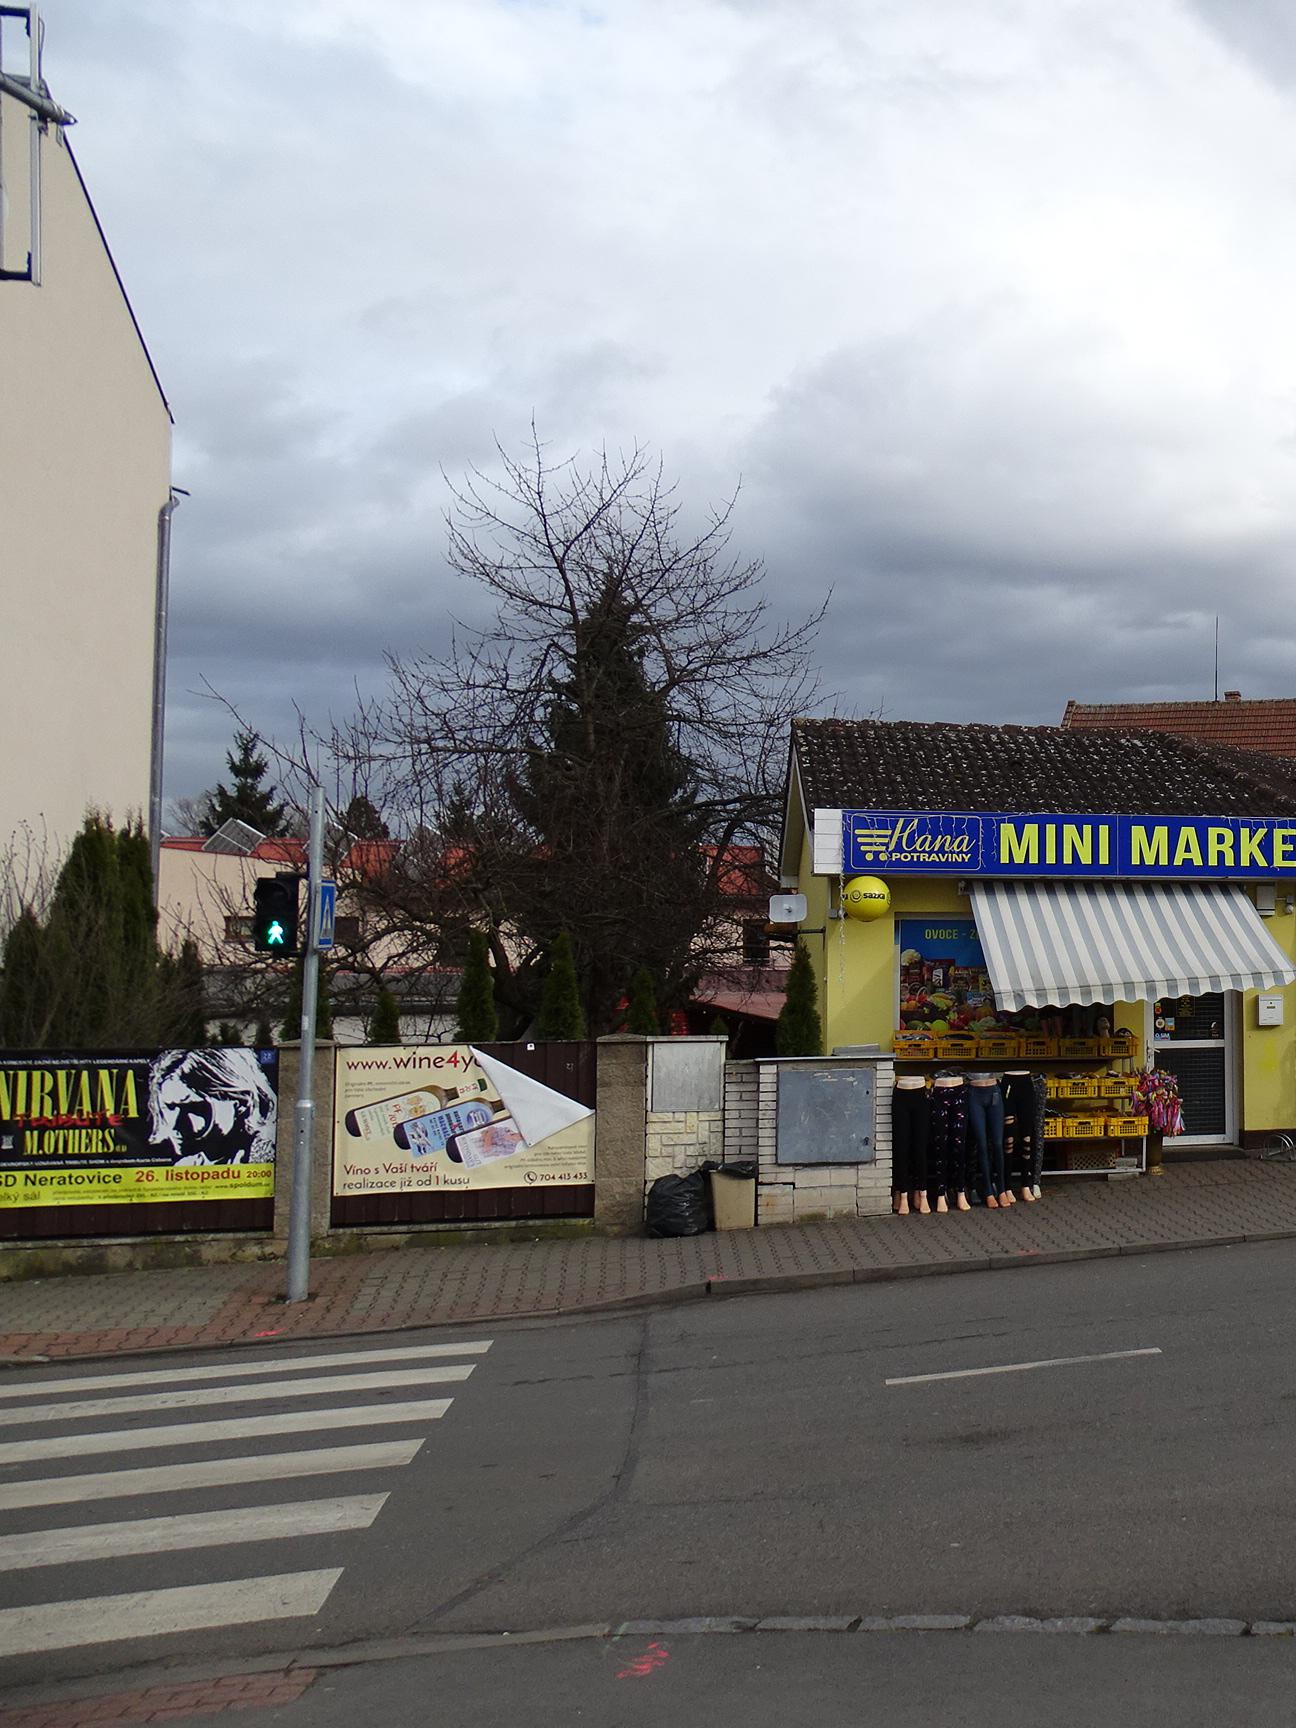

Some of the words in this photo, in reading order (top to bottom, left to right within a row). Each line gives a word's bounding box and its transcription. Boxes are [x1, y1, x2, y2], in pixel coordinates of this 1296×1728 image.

[889, 817, 976, 851] Hana
[999, 823, 1109, 865] MINI
[891, 852, 972, 863] POTRAVINY
[925, 929, 958, 940] OVOCE
[0, 1069, 139, 1120] NIRVANA
[23, 1128, 116, 1155] M.OTHERS
[344, 1164, 371, 1176] Víno
[382, 1162, 408, 1174] Vaší
[410, 1160, 438, 1173] tváří
[24, 1171, 122, 1187] Neratovice
[135, 1170, 159, 1182] 26.
[165, 1168, 241, 1183] listopadu
[246, 1170, 272, 1178] 20:00
[343, 1177, 397, 1190] realizace
[400, 1175, 413, 1188] již
[416, 1175, 432, 1186] od
[435, 1175, 440, 1186] 1
[443, 1174, 470, 1186] kusu
[539, 1173, 556, 1181] 704
